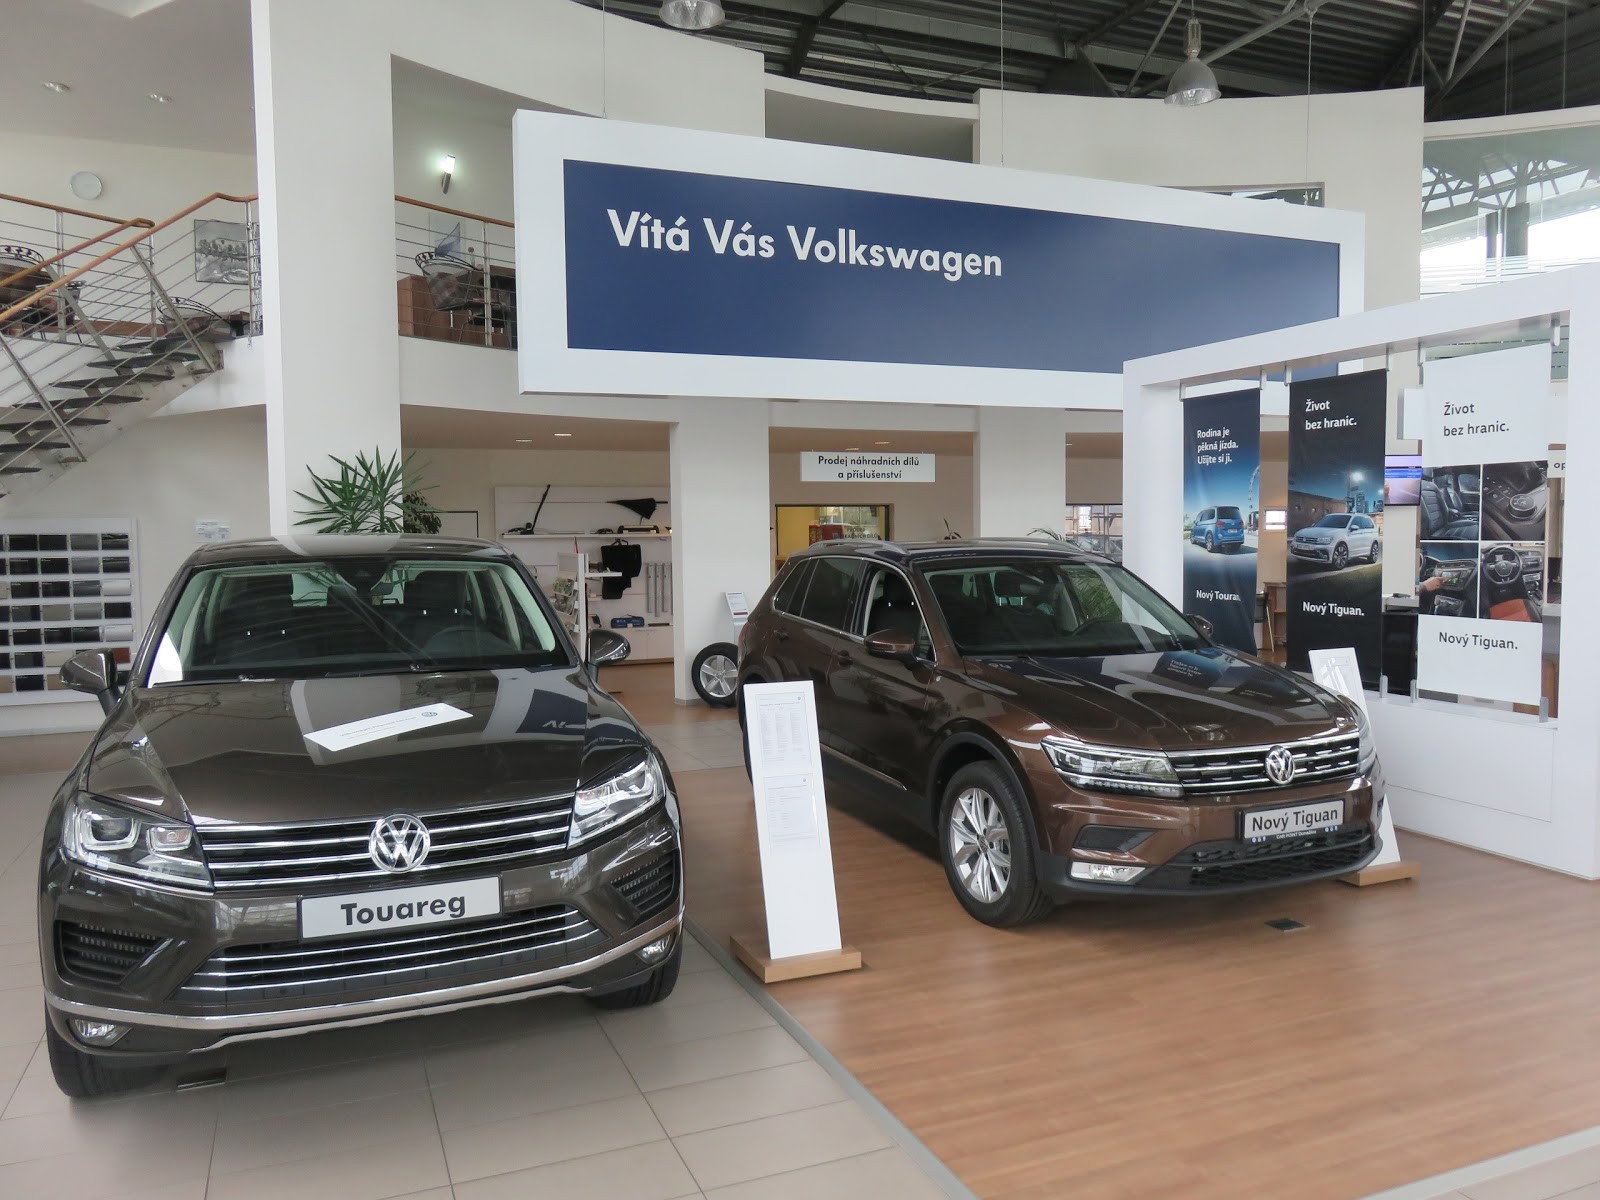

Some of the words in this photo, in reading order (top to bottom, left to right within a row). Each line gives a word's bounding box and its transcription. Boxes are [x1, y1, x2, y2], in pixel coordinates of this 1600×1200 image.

[607, 209, 690, 252] Vítá
[703, 217, 775, 258] Vás
[787, 225, 1002, 282] Volkswagen
[1305, 398, 1331, 412] Život
[1443, 401, 1475, 416] Život
[1305, 420, 1322, 431] bez
[1323, 415, 1358, 429] hranic.
[1443, 425, 1464, 437] bez
[1467, 420, 1510, 435] hranic.
[1196, 428, 1222, 439] Rodina
[1222, 426, 1230, 439] je
[1197, 440, 1218, 454] pěkná
[1218, 439, 1239, 452] jízda.
[818, 455, 848, 467] Prodej
[850, 456, 901, 466] náhradních
[903, 456, 920, 466] dílů
[1218, 453, 1225, 463] si
[837, 471, 844, 479] a
[846, 469, 902, 481] příslušenství
[1196, 589, 1214, 602] Nový
[1302, 601, 1327, 616] Nový
[1329, 602, 1365, 617] Tiguan.
[1439, 631, 1470, 648] Nový
[1471, 634, 1519, 650] Tiguan.
[1252, 812, 1289, 832] Nový
[1293, 809, 1338, 828] Tiguan
[340, 896, 466, 926] Touareg
